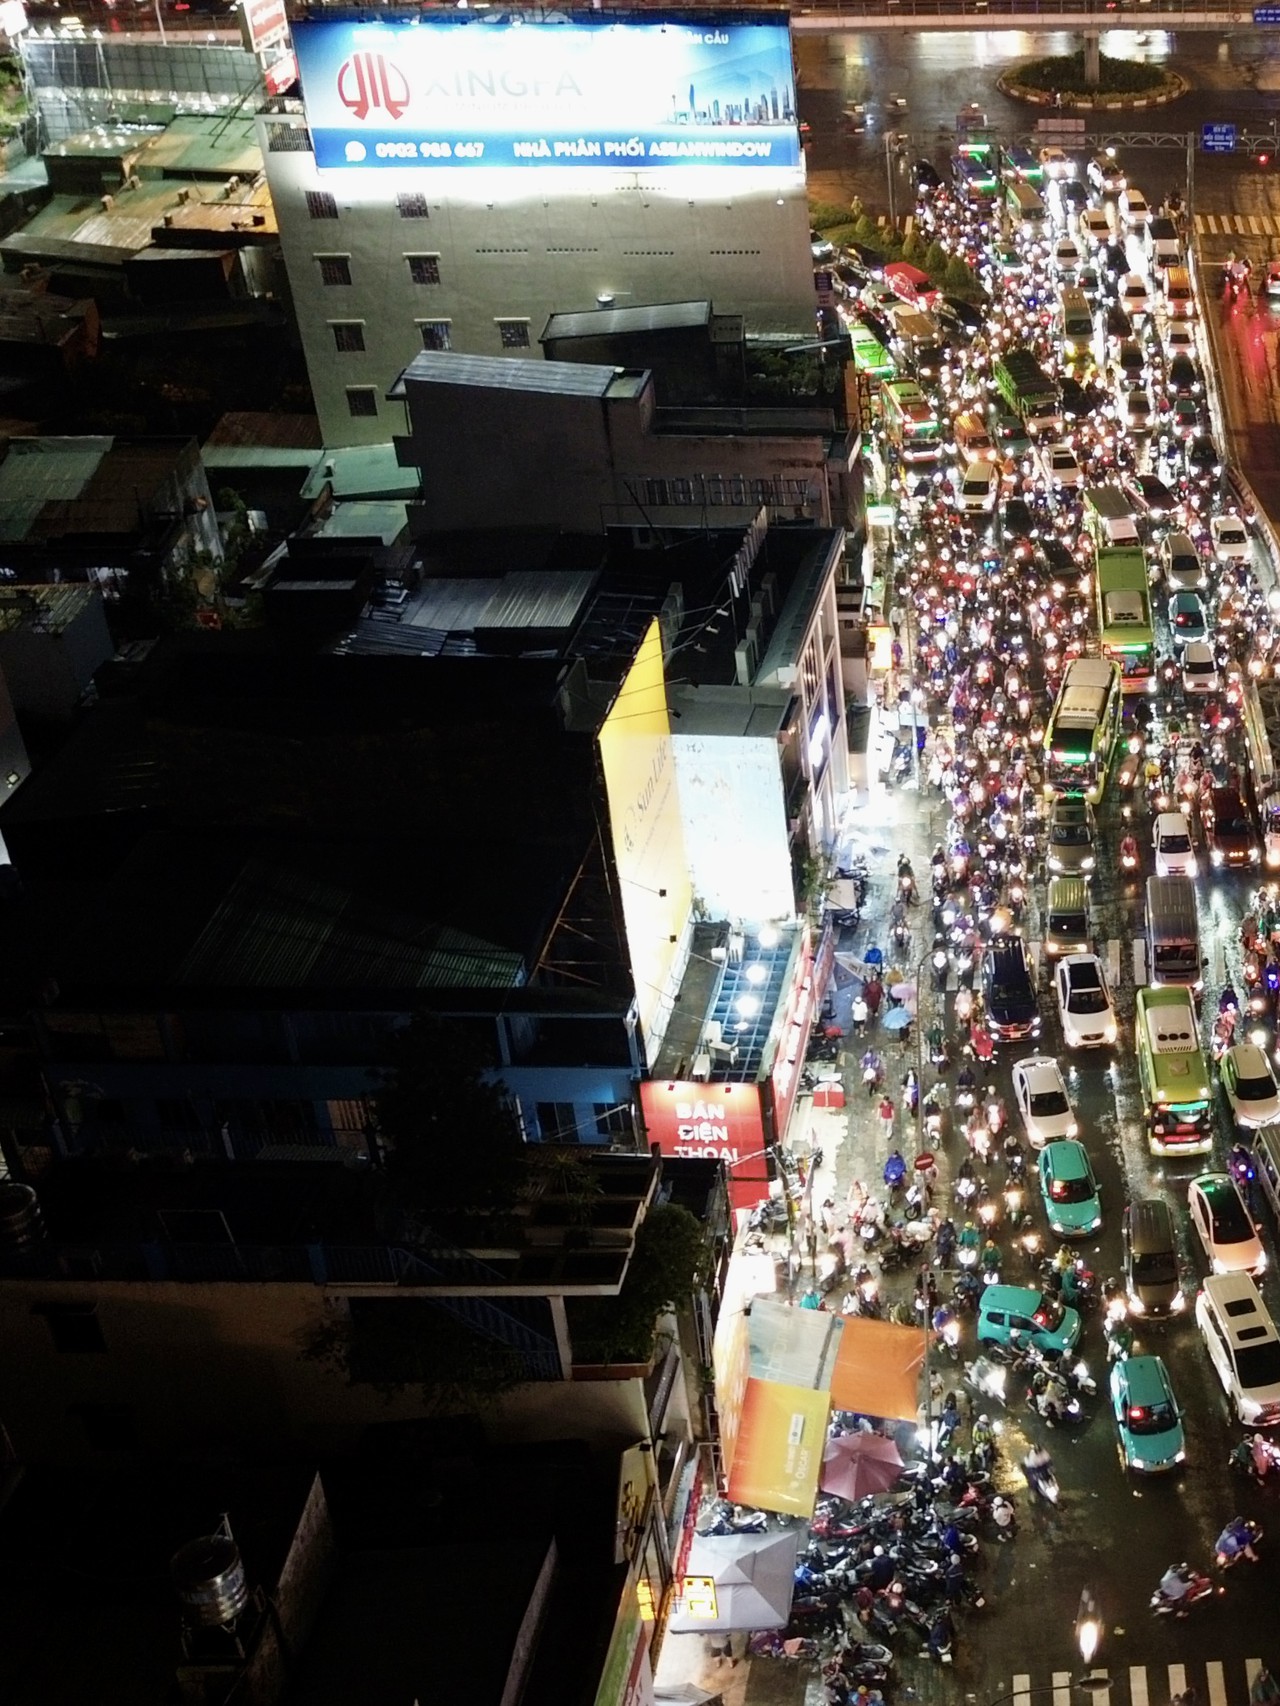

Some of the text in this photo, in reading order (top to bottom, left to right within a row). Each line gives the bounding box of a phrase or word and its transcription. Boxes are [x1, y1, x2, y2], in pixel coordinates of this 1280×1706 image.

[513, 138, 552, 157] NHÀ
[554, 138, 601, 157] PHÂN
[604, 137, 645, 156] PHỐI
[675, 1100, 725, 1120] BÁN
[677, 1121, 729, 1144] ĐIỆN
[673, 1146, 738, 1165] THOẠI
